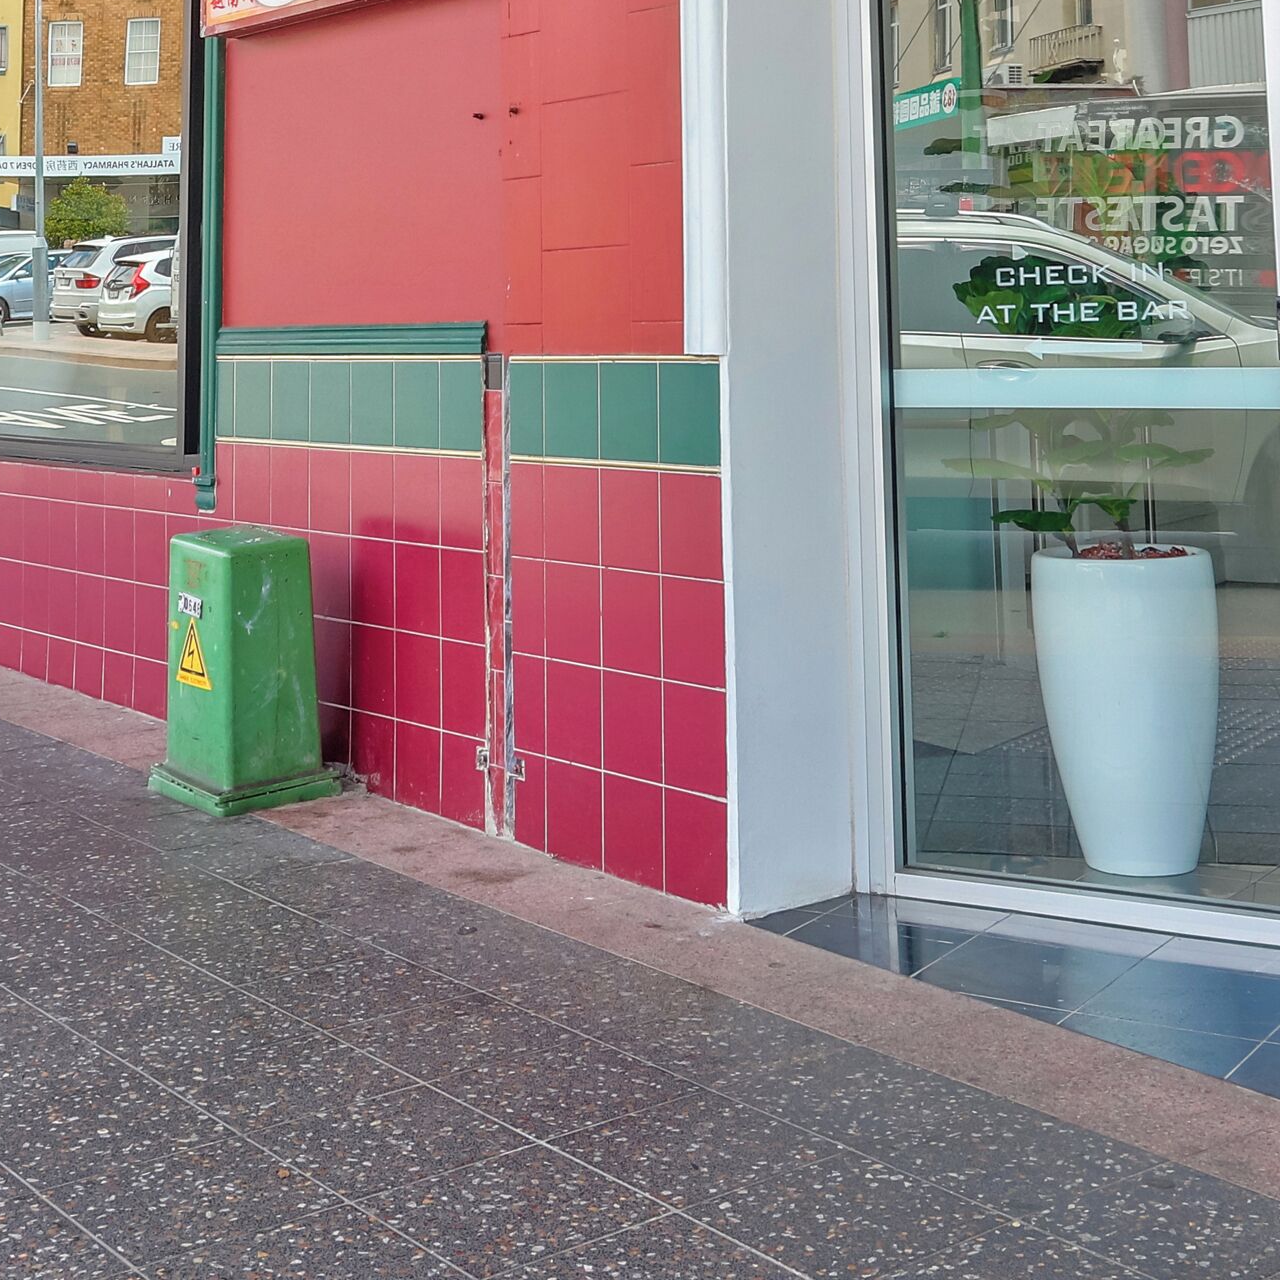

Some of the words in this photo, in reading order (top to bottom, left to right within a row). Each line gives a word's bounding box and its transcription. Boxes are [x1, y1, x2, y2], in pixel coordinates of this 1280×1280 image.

[995, 264, 1113, 287] CHECK
[1130, 261, 1165, 282] IN
[976, 304, 1017, 324] AT
[1030, 302, 1100, 323] THE
[1117, 300, 1190, 321] BAR
